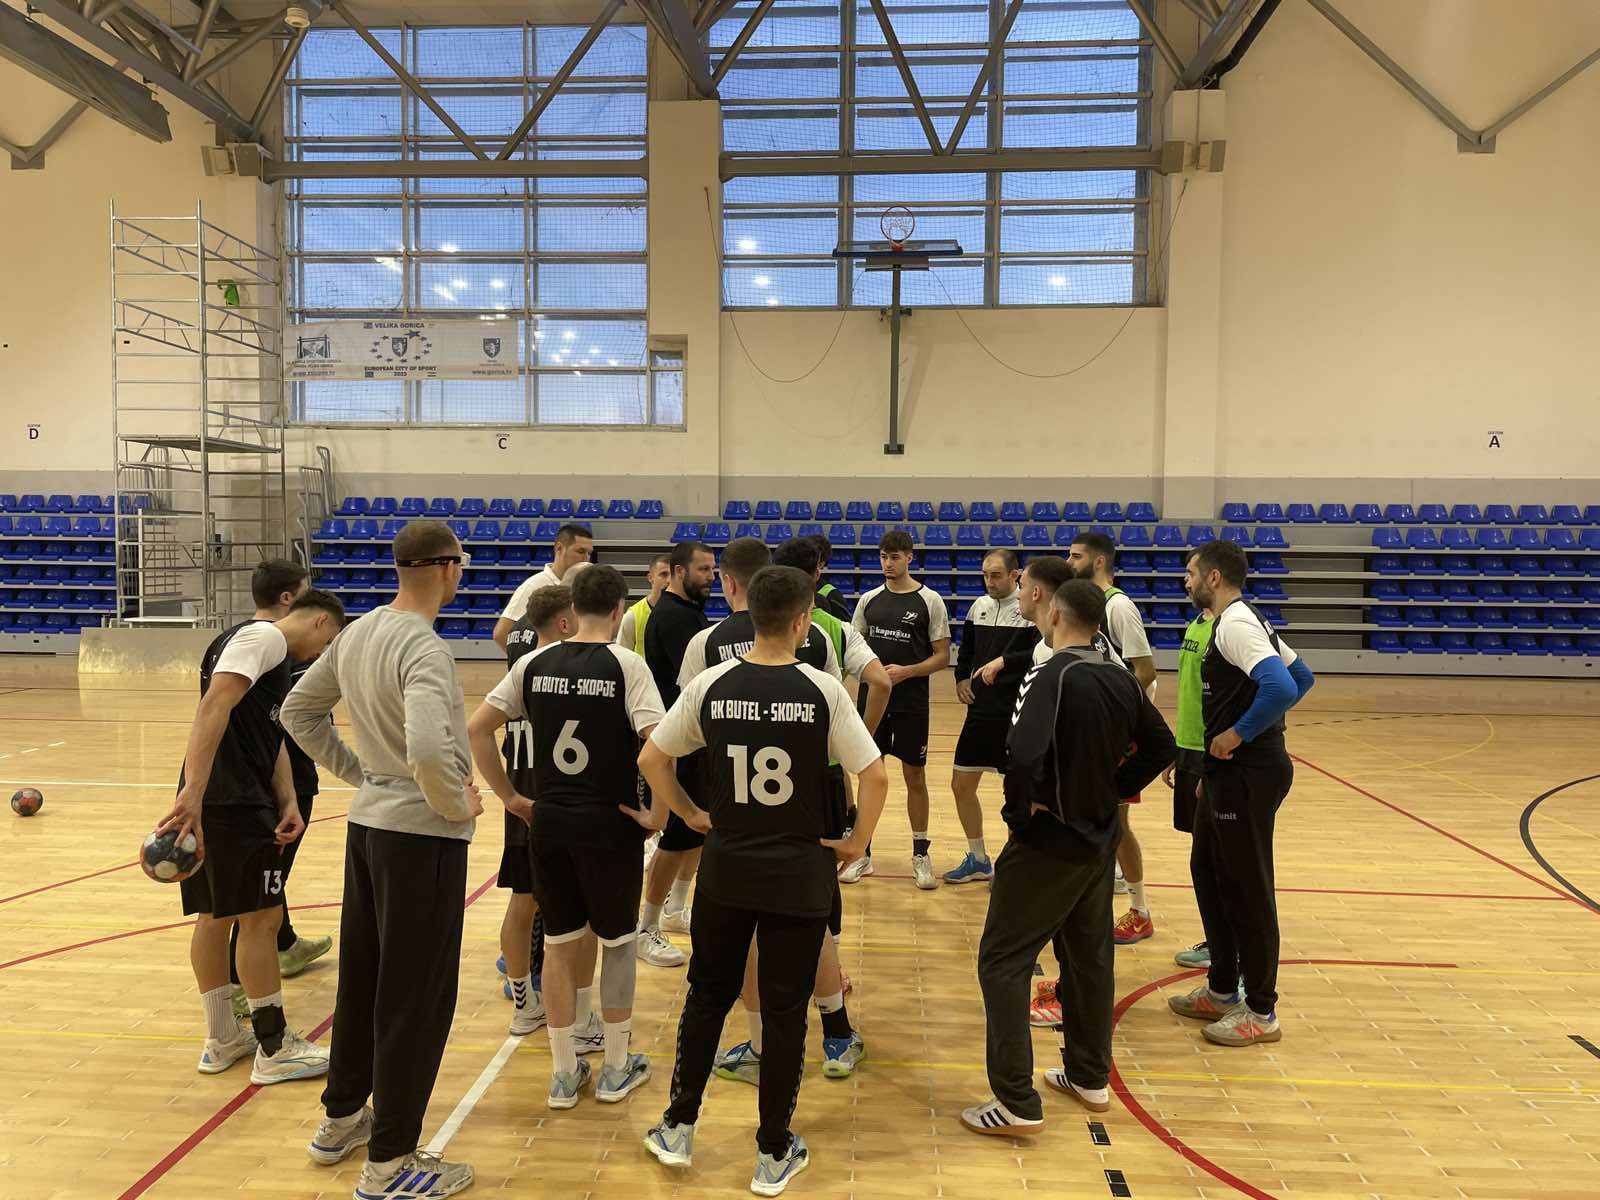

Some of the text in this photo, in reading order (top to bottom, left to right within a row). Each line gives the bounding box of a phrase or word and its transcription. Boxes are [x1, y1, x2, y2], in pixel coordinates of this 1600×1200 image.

[29, 428, 39, 440] D
[498, 437, 507, 449] C
[1488, 435, 1501, 448] A
[718, 643, 733, 661] RK
[532, 676, 543, 692] RK
[541, 676, 570, 695] BUTEL
[577, 679, 616, 698] SKOPJE
[711, 700, 725, 719] RK
[726, 700, 761, 721] BUTEL
[770, 703, 816, 723] SKOPJE
[553, 719, 589, 775] 6
[727, 744, 794, 806] 18
[263, 870, 282, 894] 13
